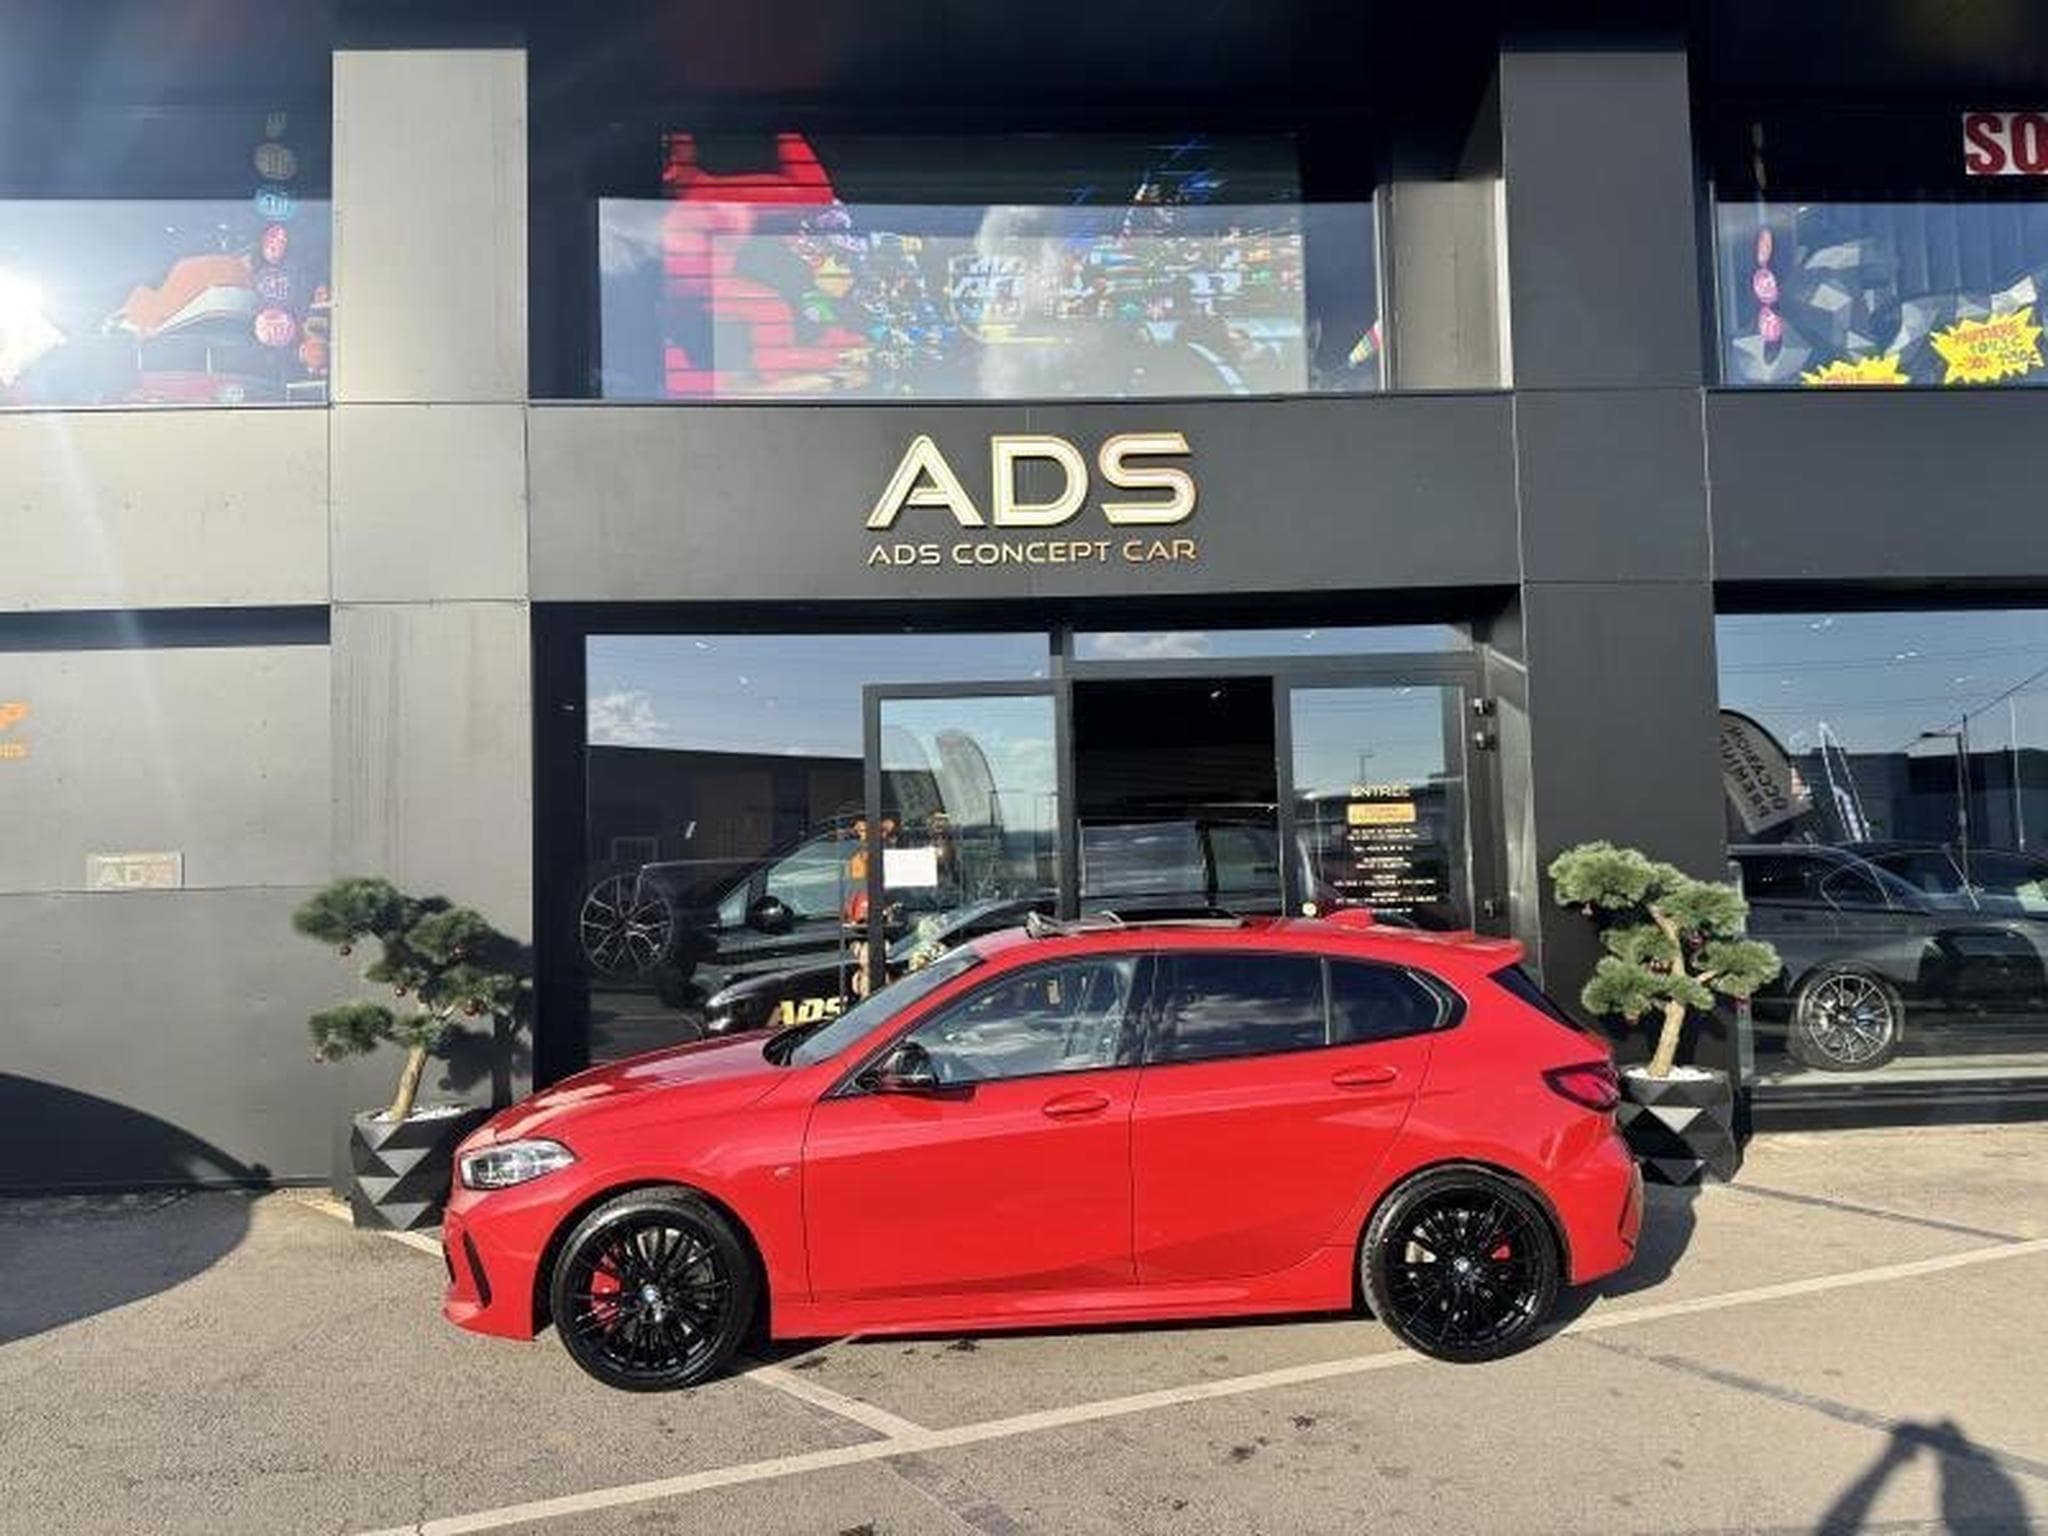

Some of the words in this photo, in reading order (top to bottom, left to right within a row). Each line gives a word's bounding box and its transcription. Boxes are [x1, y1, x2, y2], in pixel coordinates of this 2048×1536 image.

[1966, 113, 2048, 173] SO
[866, 431, 1197, 528] ADS
[868, 544, 940, 565] ADS
[951, 541, 1112, 565] CONCEPT
[1123, 539, 1197, 562] CAR
[766, 995, 848, 1027] ADS
